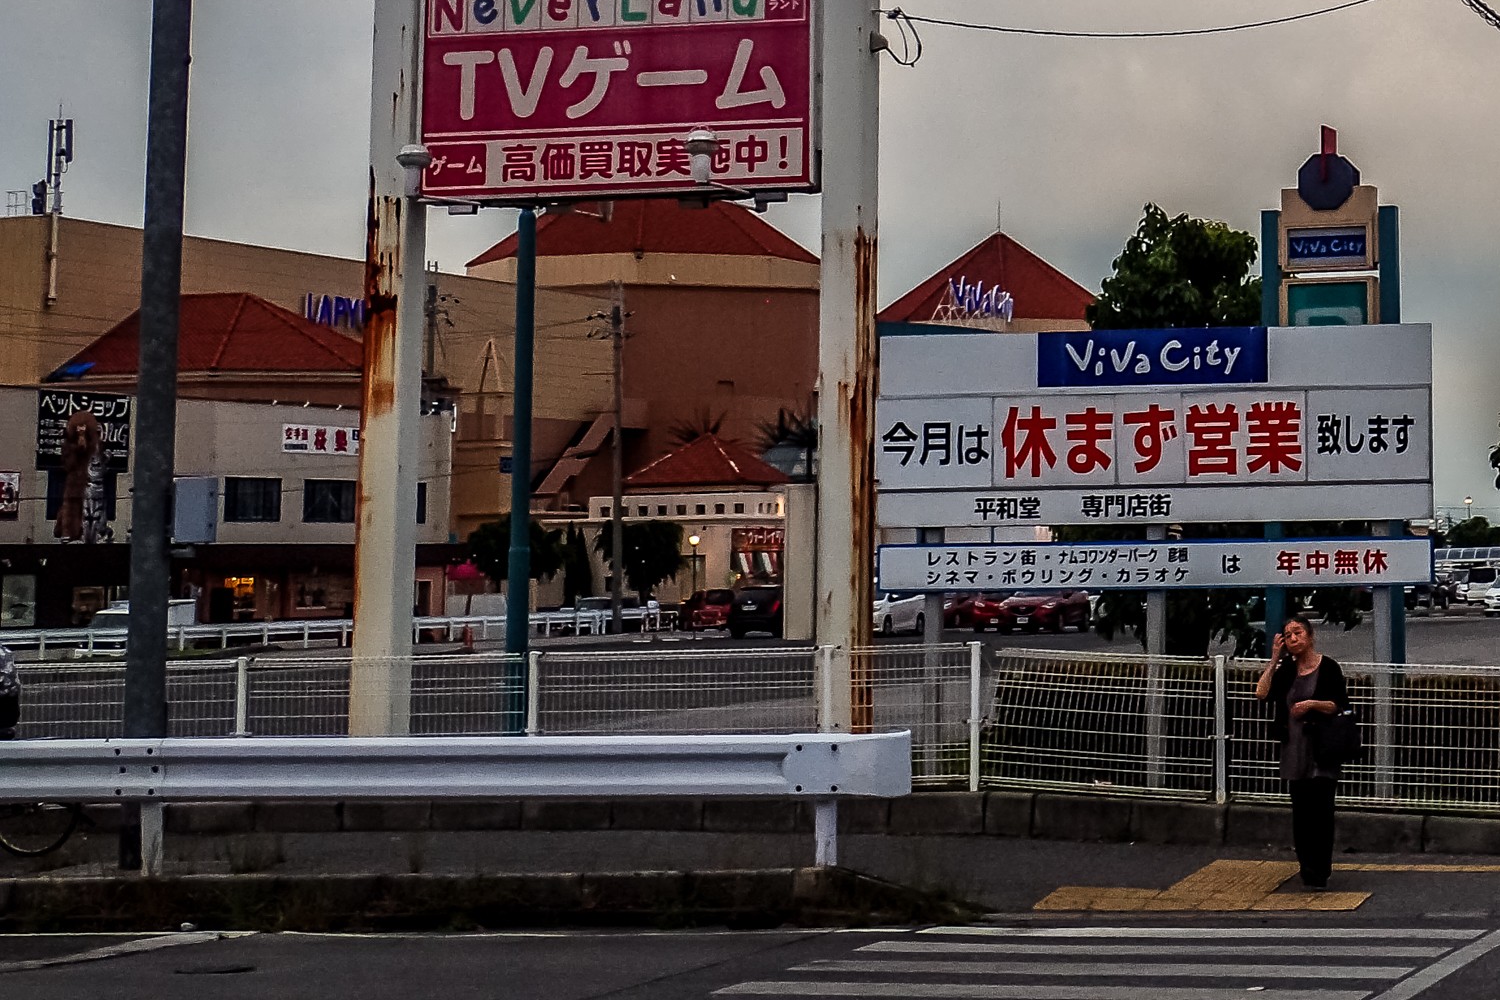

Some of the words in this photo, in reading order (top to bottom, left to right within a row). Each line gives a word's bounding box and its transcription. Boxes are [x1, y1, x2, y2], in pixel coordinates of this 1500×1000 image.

[443, 38, 786, 121] TVゲーム
[429, 155, 483, 176] ゲーム
[1066, 339, 1151, 376] ViVa
[1159, 339, 1242, 375] City
[41, 393, 131, 418] ペットショップ
[882, 421, 990, 468] 今月は
[1001, 402, 1303, 479] 休まず営業
[1316, 414, 1416, 456] 致します
[974, 496, 1041, 520] 平和堂
[1081, 493, 1172, 518] 専門店街
[927, 567, 1189, 585] シネマ・ボウリング・カラオケ
[1221, 554, 1241, 575] は
[1276, 549, 1389, 576] 年中無休
